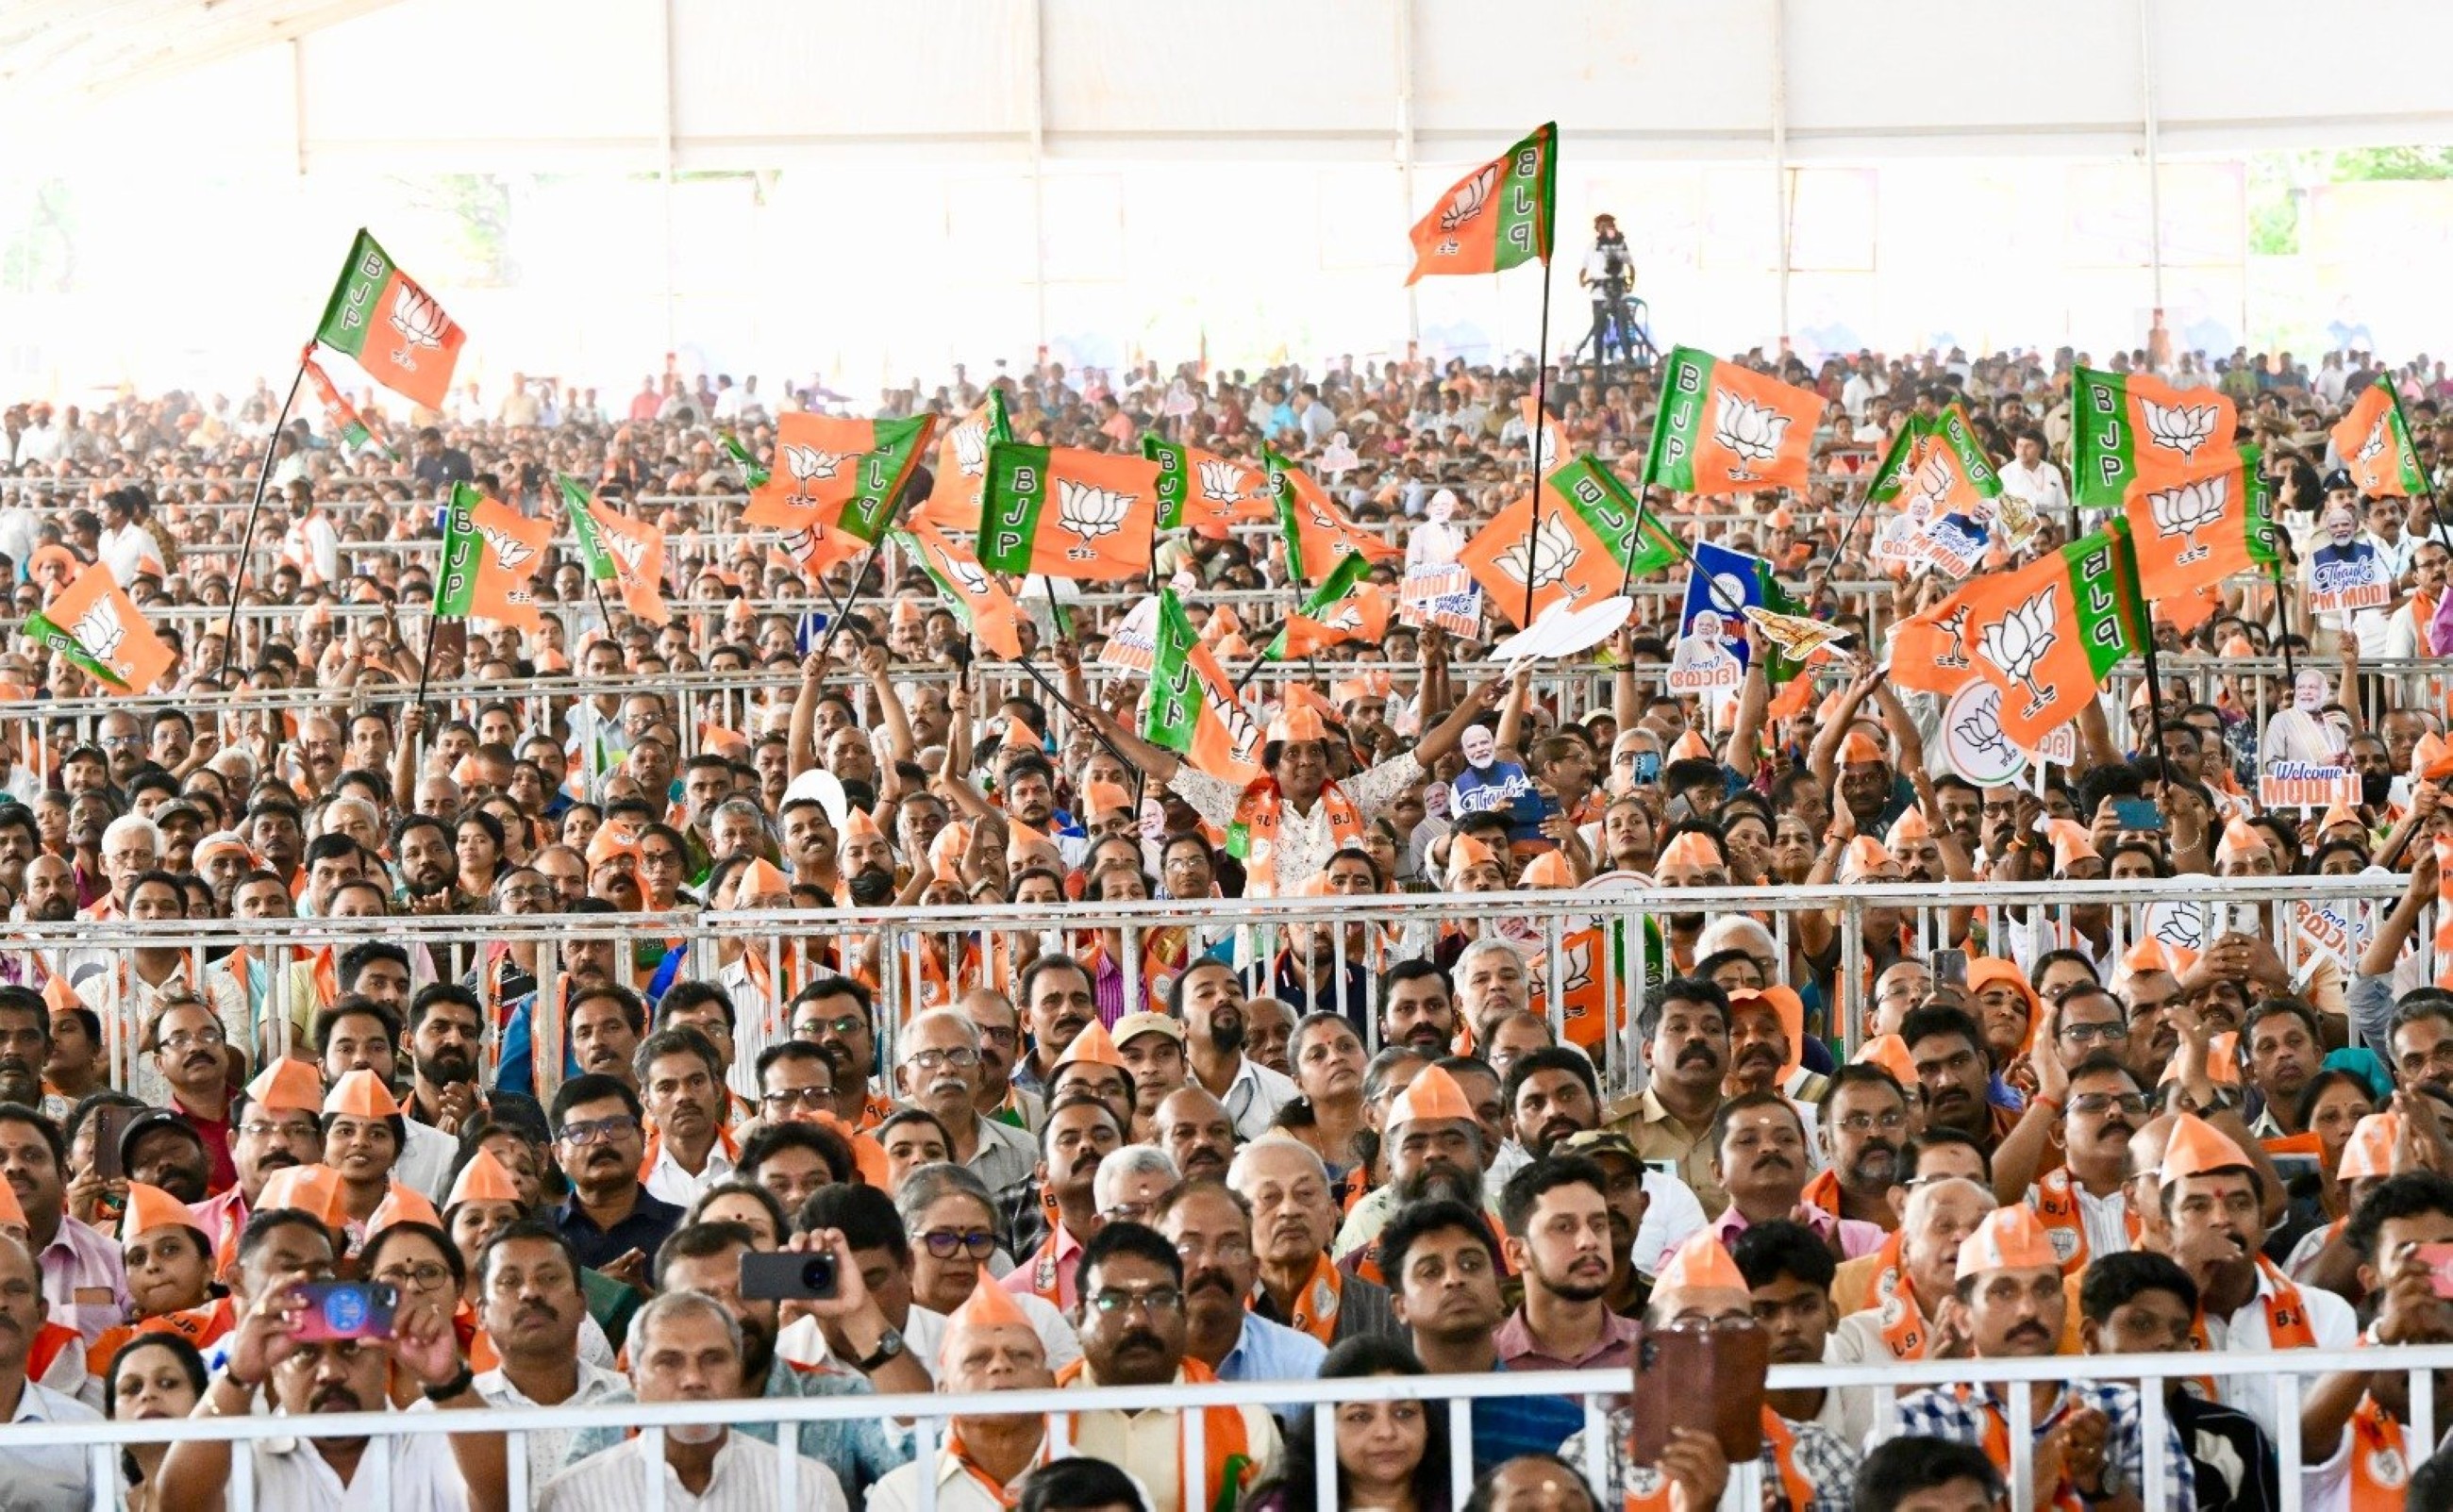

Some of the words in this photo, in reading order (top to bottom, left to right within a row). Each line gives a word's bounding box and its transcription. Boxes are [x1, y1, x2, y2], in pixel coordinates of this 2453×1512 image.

[341, 251, 384, 330] BJP
[1664, 363, 1700, 468] BJP
[2092, 384, 2123, 486] BJP
[997, 467, 1036, 557] BJP
[1157, 448, 1177, 524] BJP
[446, 507, 474, 603] BJP
[2314, 555, 2375, 592] Thank
[2309, 590, 2336, 611] PM
[2341, 585, 2389, 608] MODI
[1164, 627, 1190, 728] JP
[2262, 776, 2332, 805] MODI
[2275, 762, 2343, 781] Welcome
[1332, 811, 1353, 825] BJ
[2044, 1199, 2067, 1216] BJ
[2275, 1304, 2303, 1327] BJ
